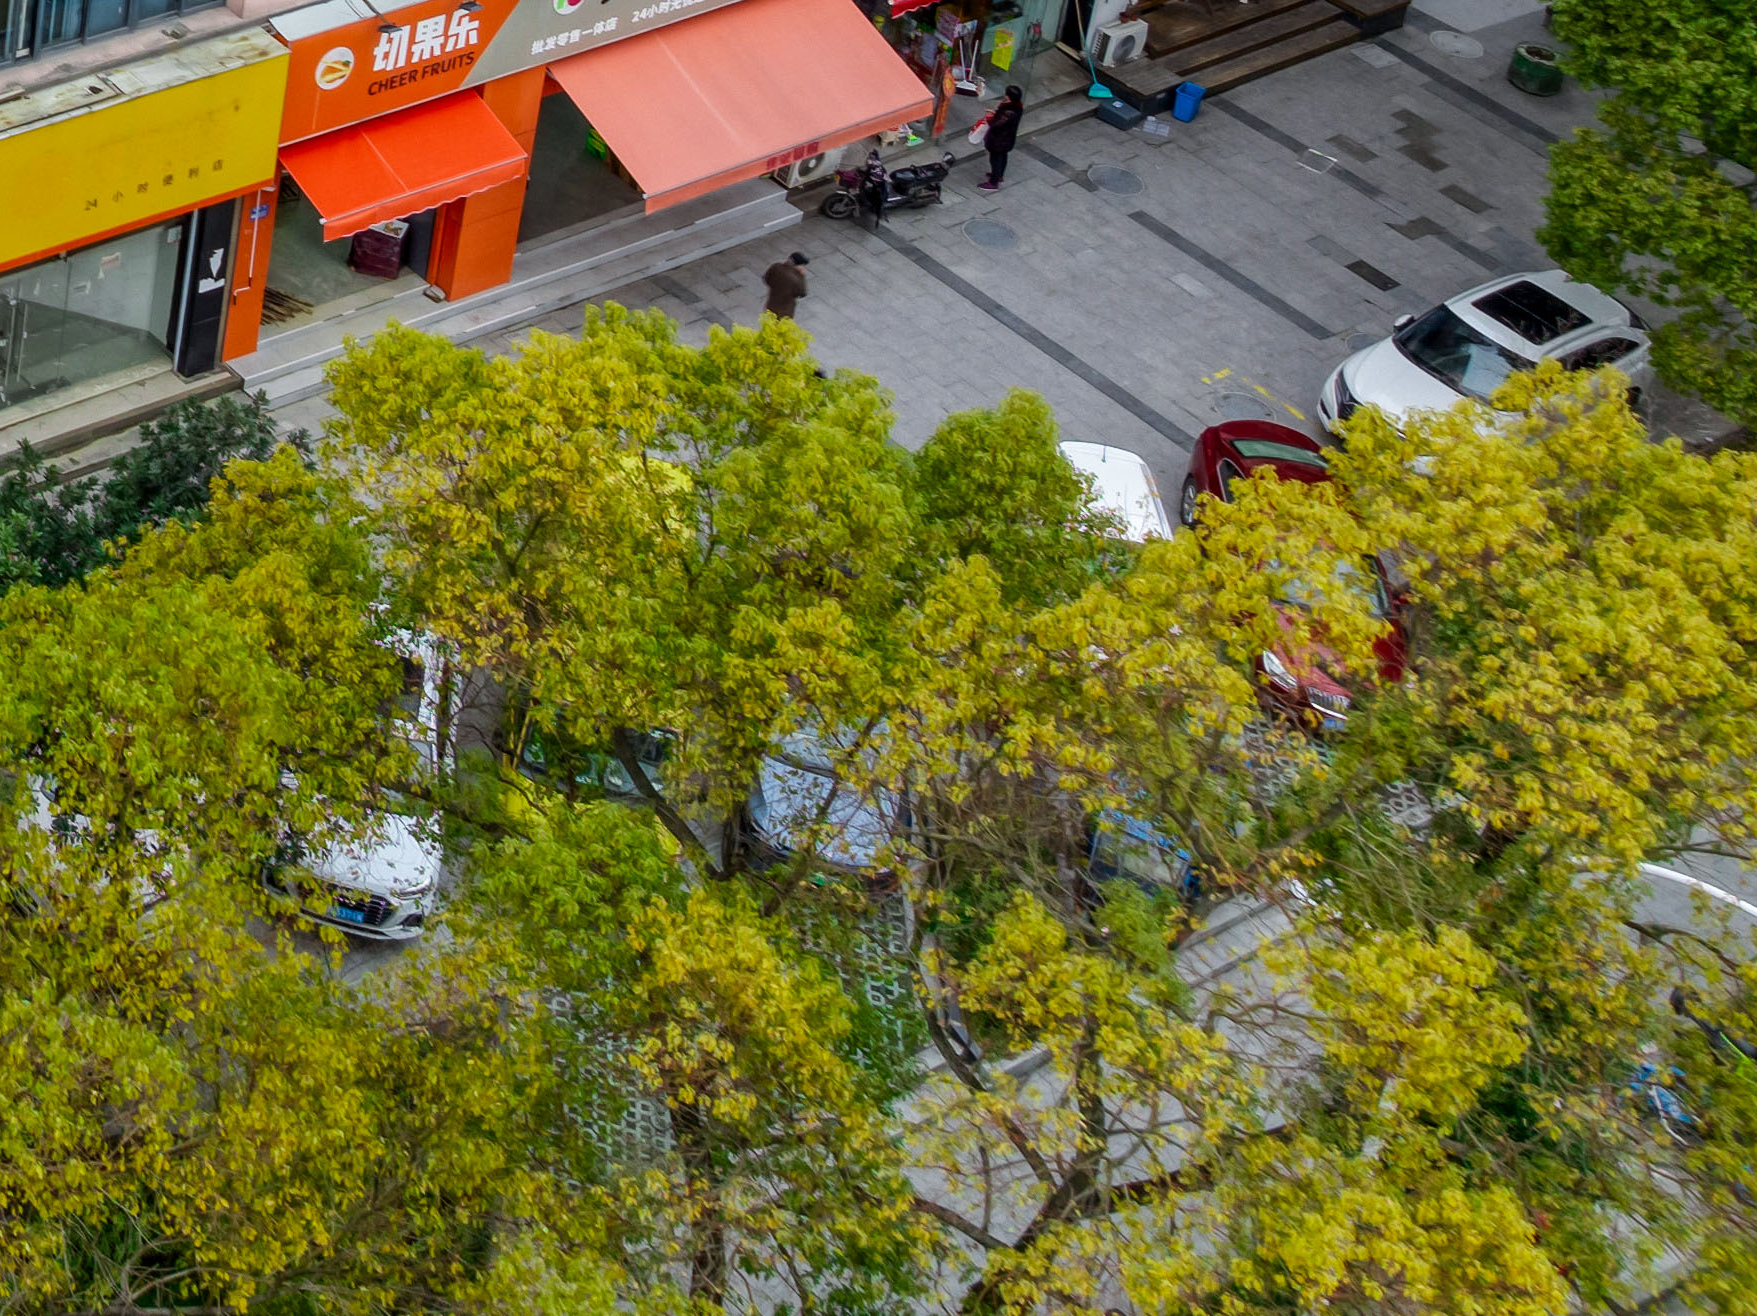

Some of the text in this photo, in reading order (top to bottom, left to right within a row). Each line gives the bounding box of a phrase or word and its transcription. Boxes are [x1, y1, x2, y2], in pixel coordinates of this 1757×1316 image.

[372, 8, 480, 72] 切果乐
[367, 50, 476, 97] CHEER FRUITS
